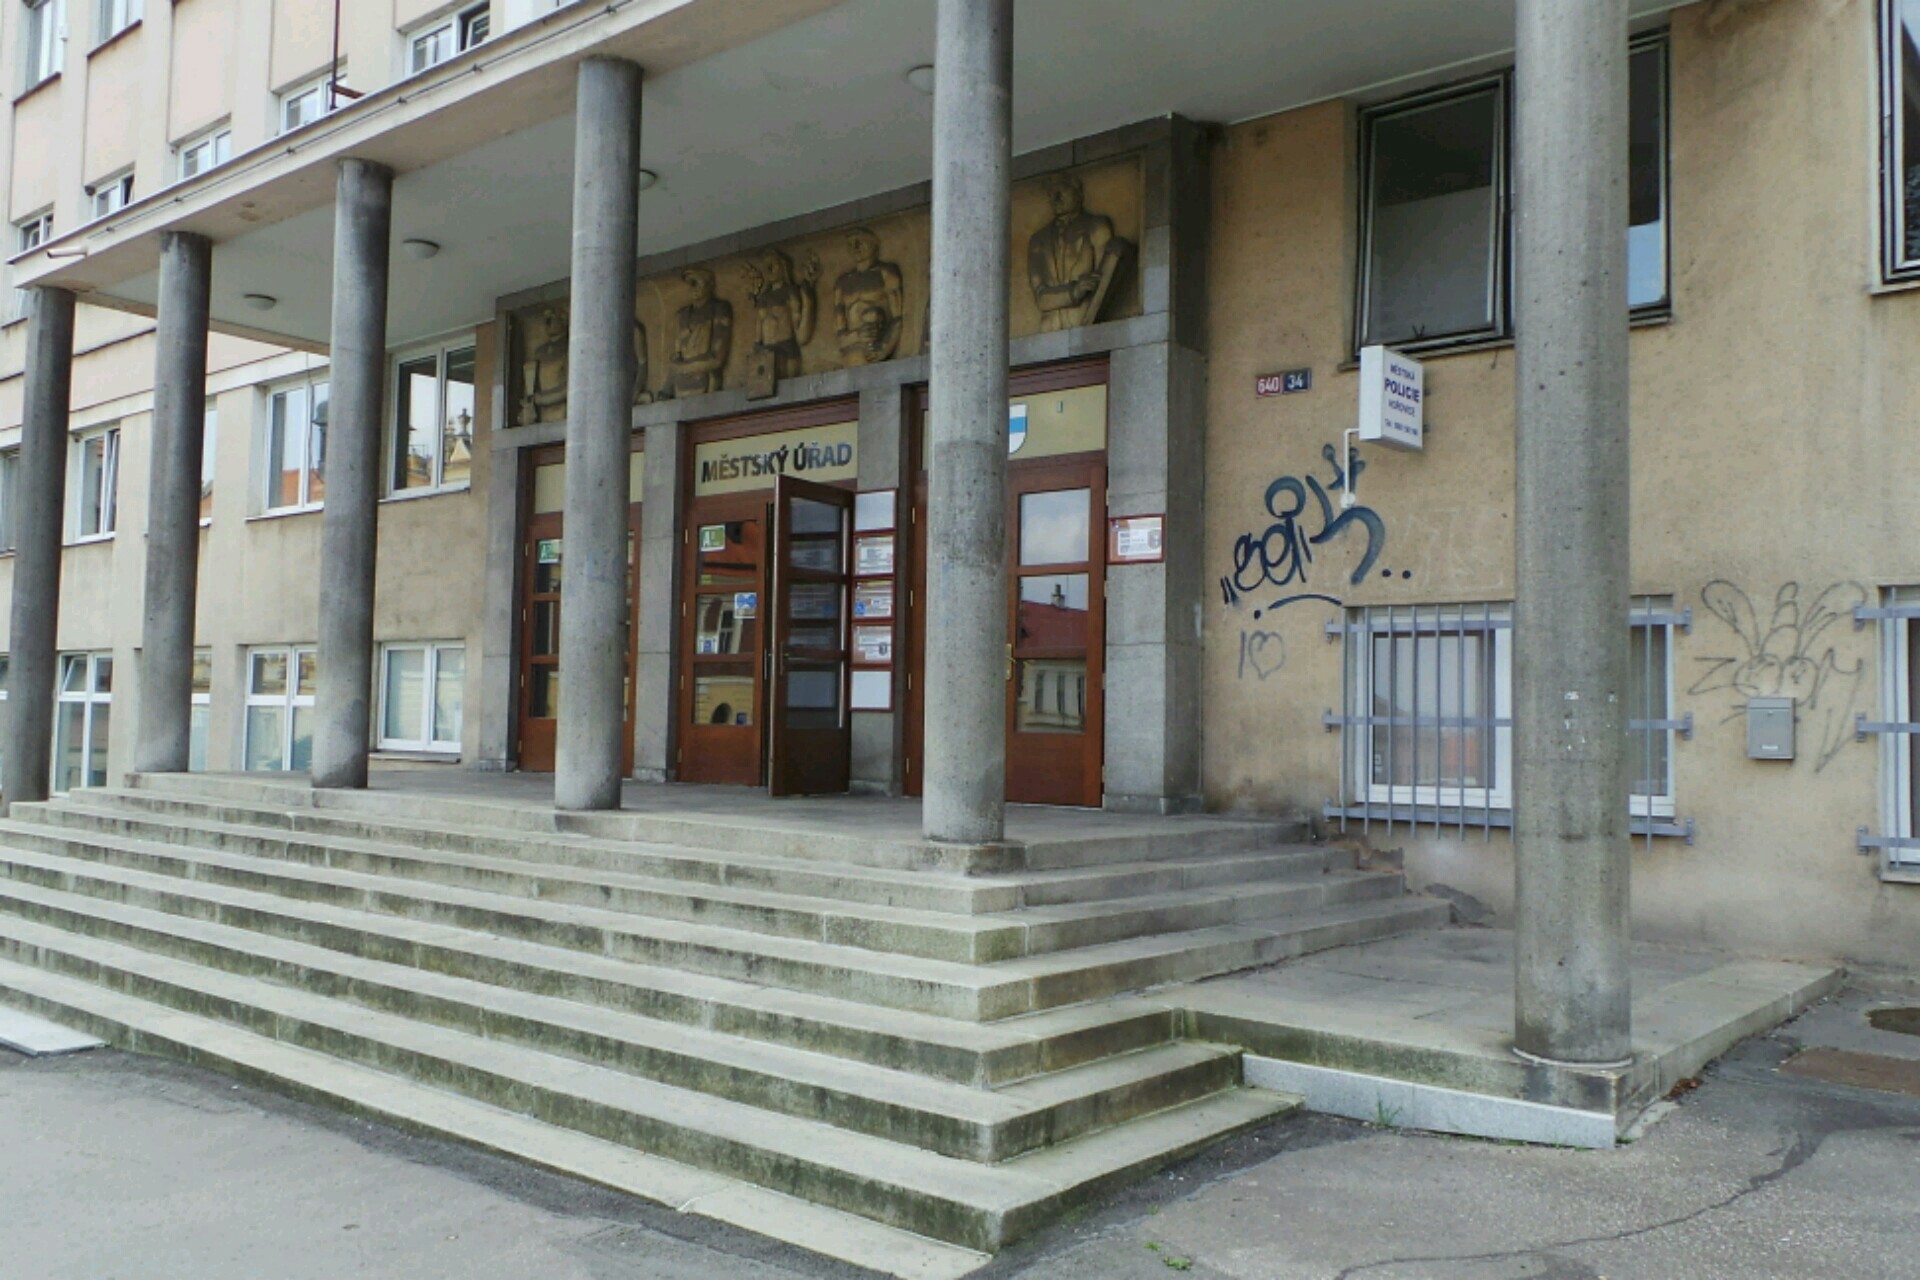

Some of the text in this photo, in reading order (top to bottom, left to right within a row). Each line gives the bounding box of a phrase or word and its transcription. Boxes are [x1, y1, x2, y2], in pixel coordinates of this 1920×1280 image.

[1257, 376, 1279, 393] 640
[1287, 373, 1303, 390] 34
[701, 441, 853, 483] MĚSTSKÝ ÚŘAD
